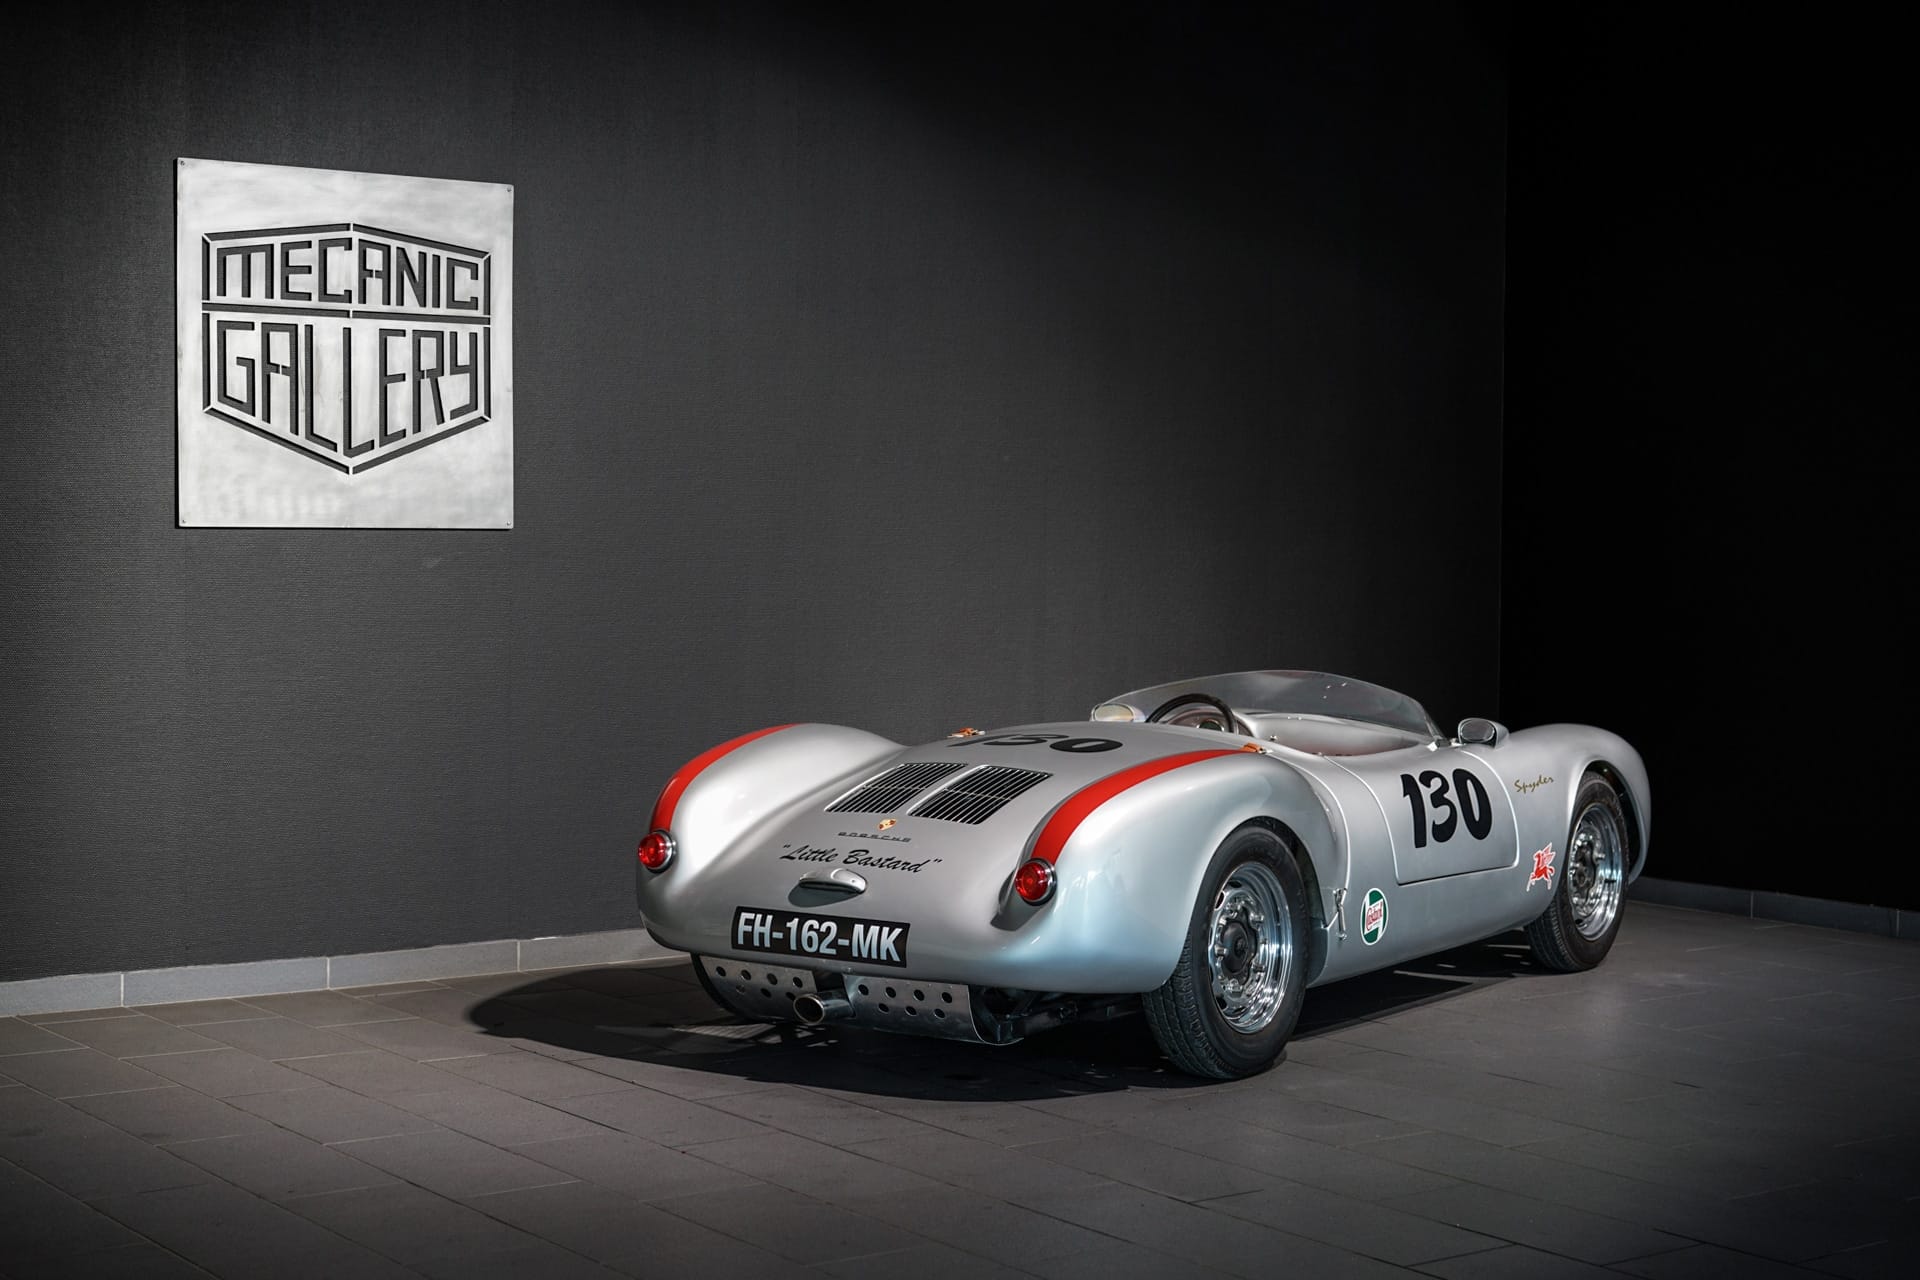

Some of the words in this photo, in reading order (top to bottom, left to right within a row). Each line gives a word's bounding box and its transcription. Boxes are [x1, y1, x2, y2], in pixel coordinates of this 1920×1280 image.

[216, 237, 479, 311] MECANIC
[216, 319, 479, 457] GALLERY
[946, 734, 1123, 753] 130
[1400, 768, 1493, 849] 130
[1514, 774, 1555, 794] Spyder
[838, 831, 912, 843] PORSCHE
[736, 911, 903, 963] FH-162-MK
